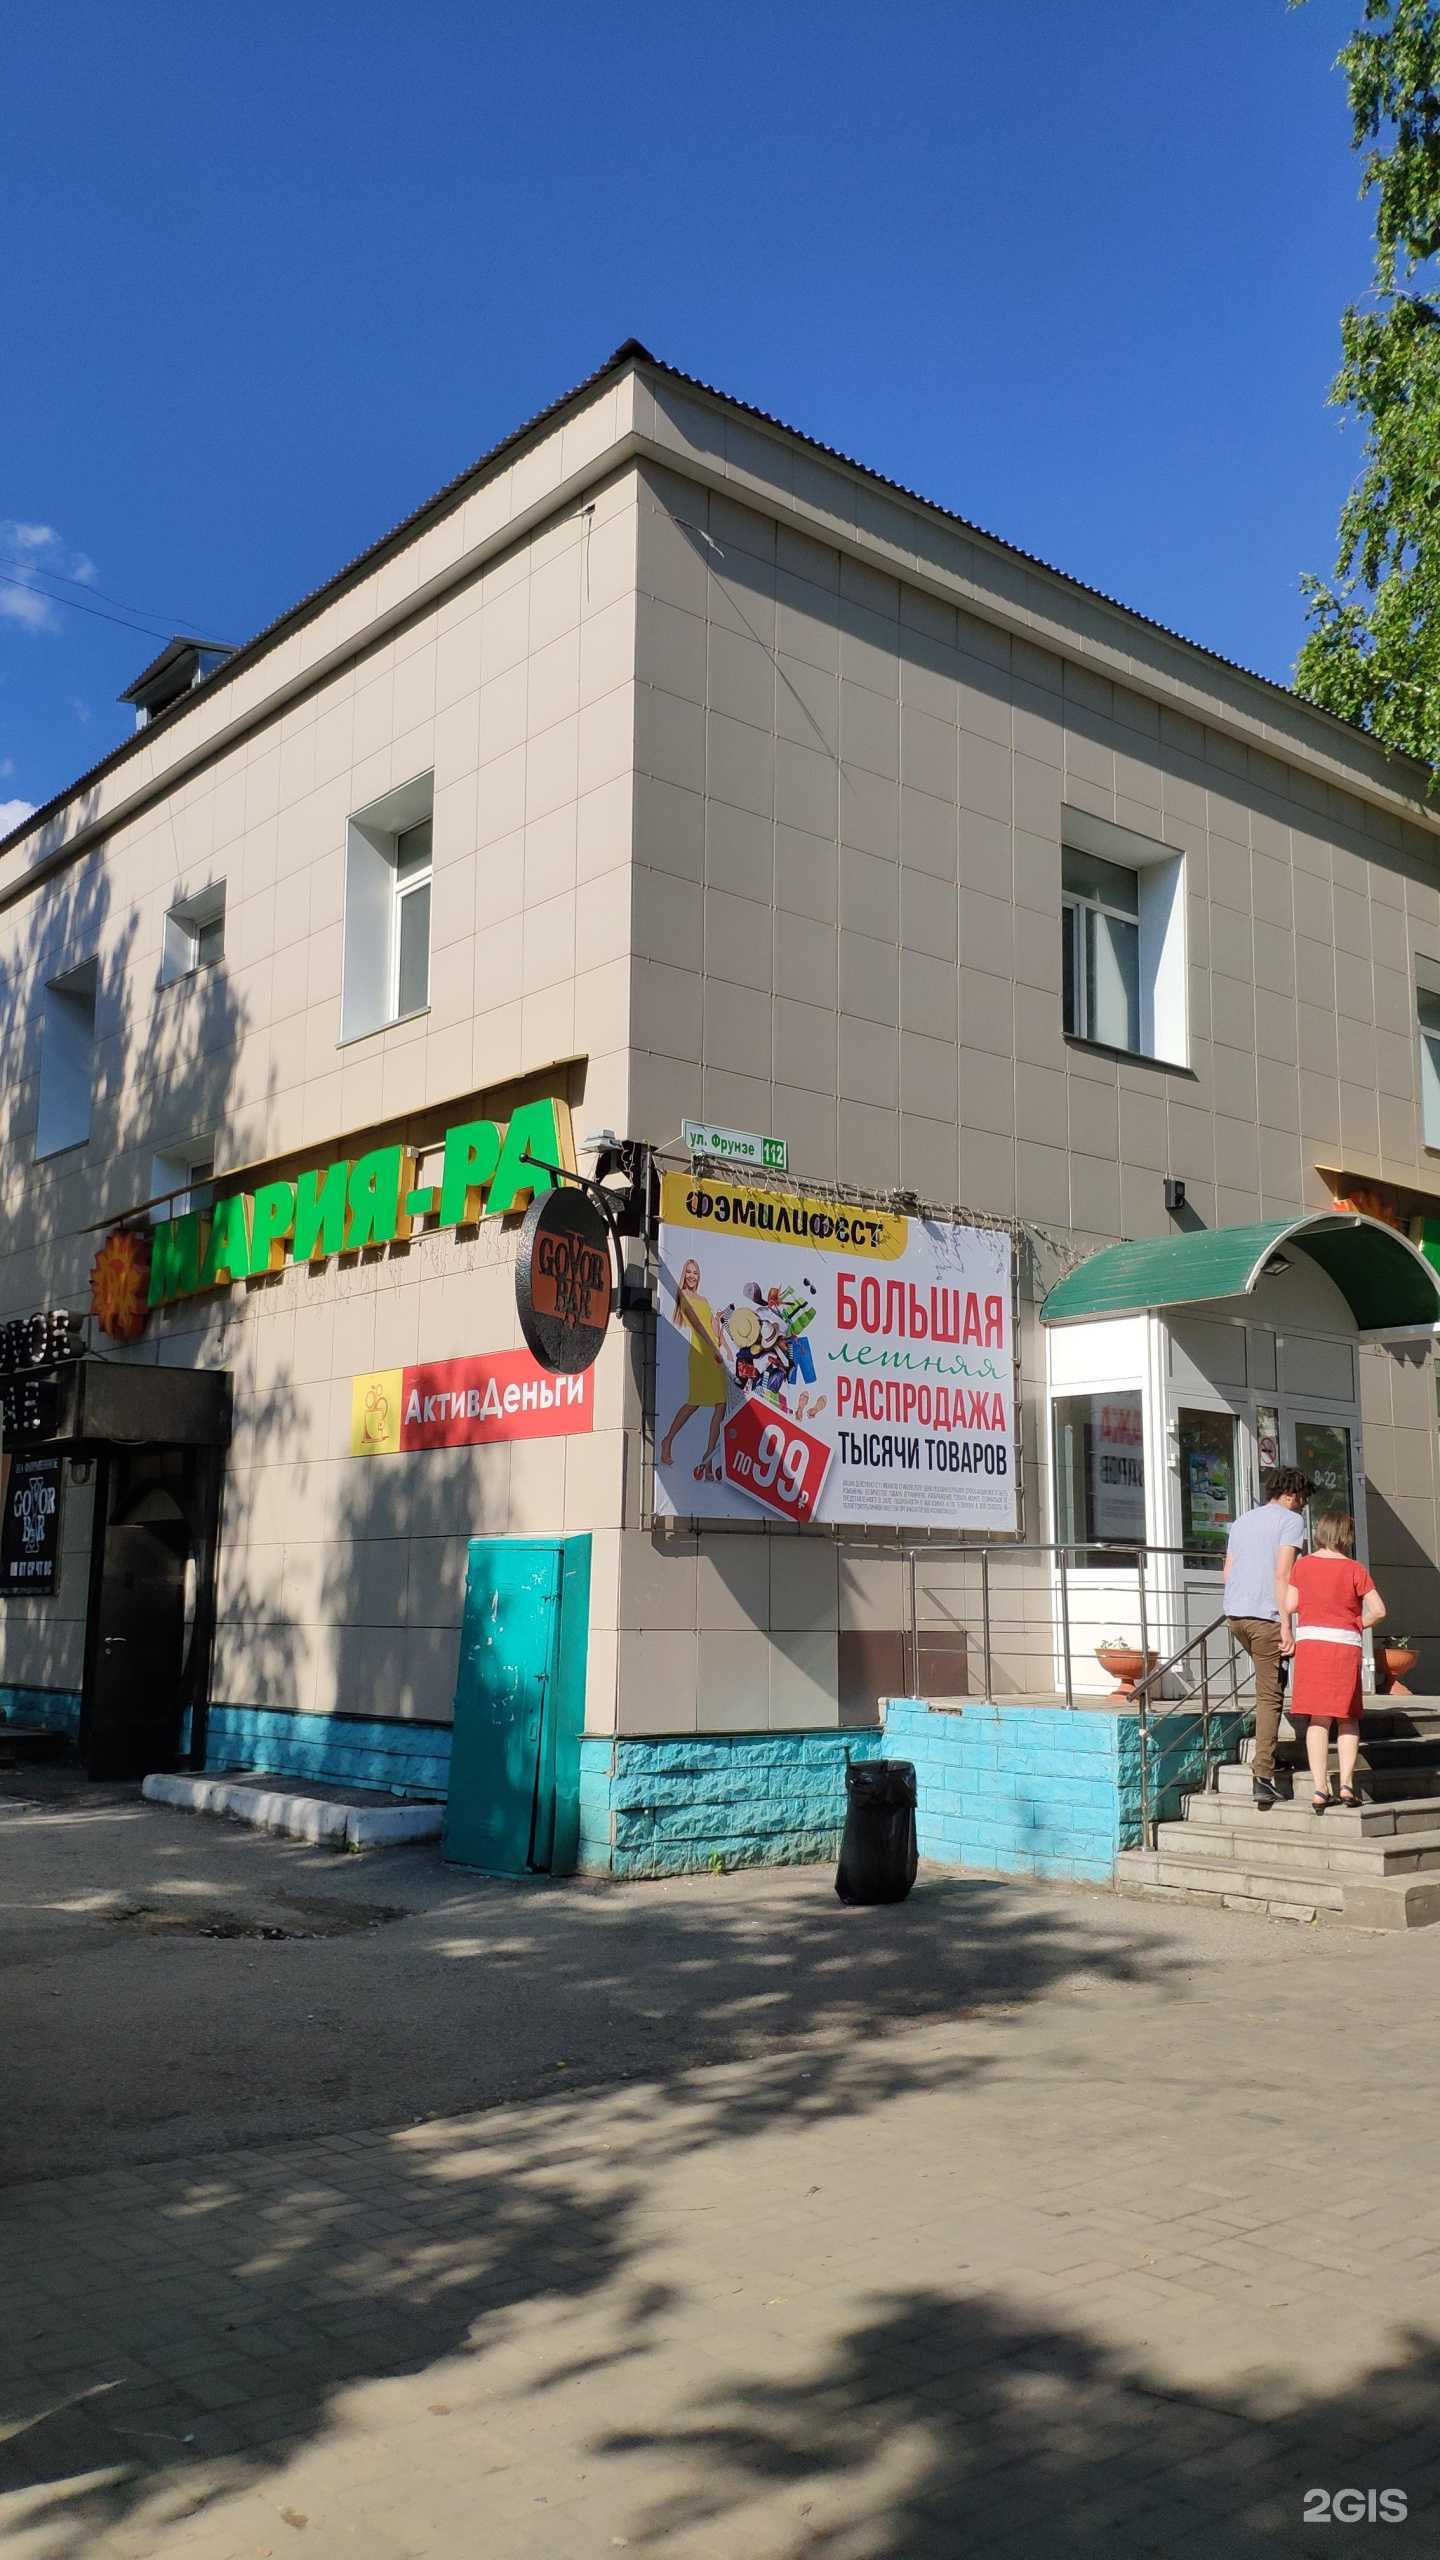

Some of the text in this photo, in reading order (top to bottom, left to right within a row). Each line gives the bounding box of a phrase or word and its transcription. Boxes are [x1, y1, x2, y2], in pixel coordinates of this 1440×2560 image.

[689, 1130, 784, 1166] ул. Фрунзе 112
[147, 1097, 568, 1308] МАРИЯ-РА
[538, 1229, 604, 1291] GOVOR
[554, 1276, 592, 1328] BAR
[837, 1272, 1003, 1349] БОЛЬШАЯ
[827, 1343, 1008, 1380] летняя
[404, 1375, 584, 1425] АктивДеньги
[837, 1375, 1006, 1432] РАСПРОДАЖА
[838, 1431, 1007, 1476] ТЫСЯЧИ ТОВАРОВ
[14, 1477, 56, 1518] GOVOR
[1314, 1469, 1337, 1489] 8-22
